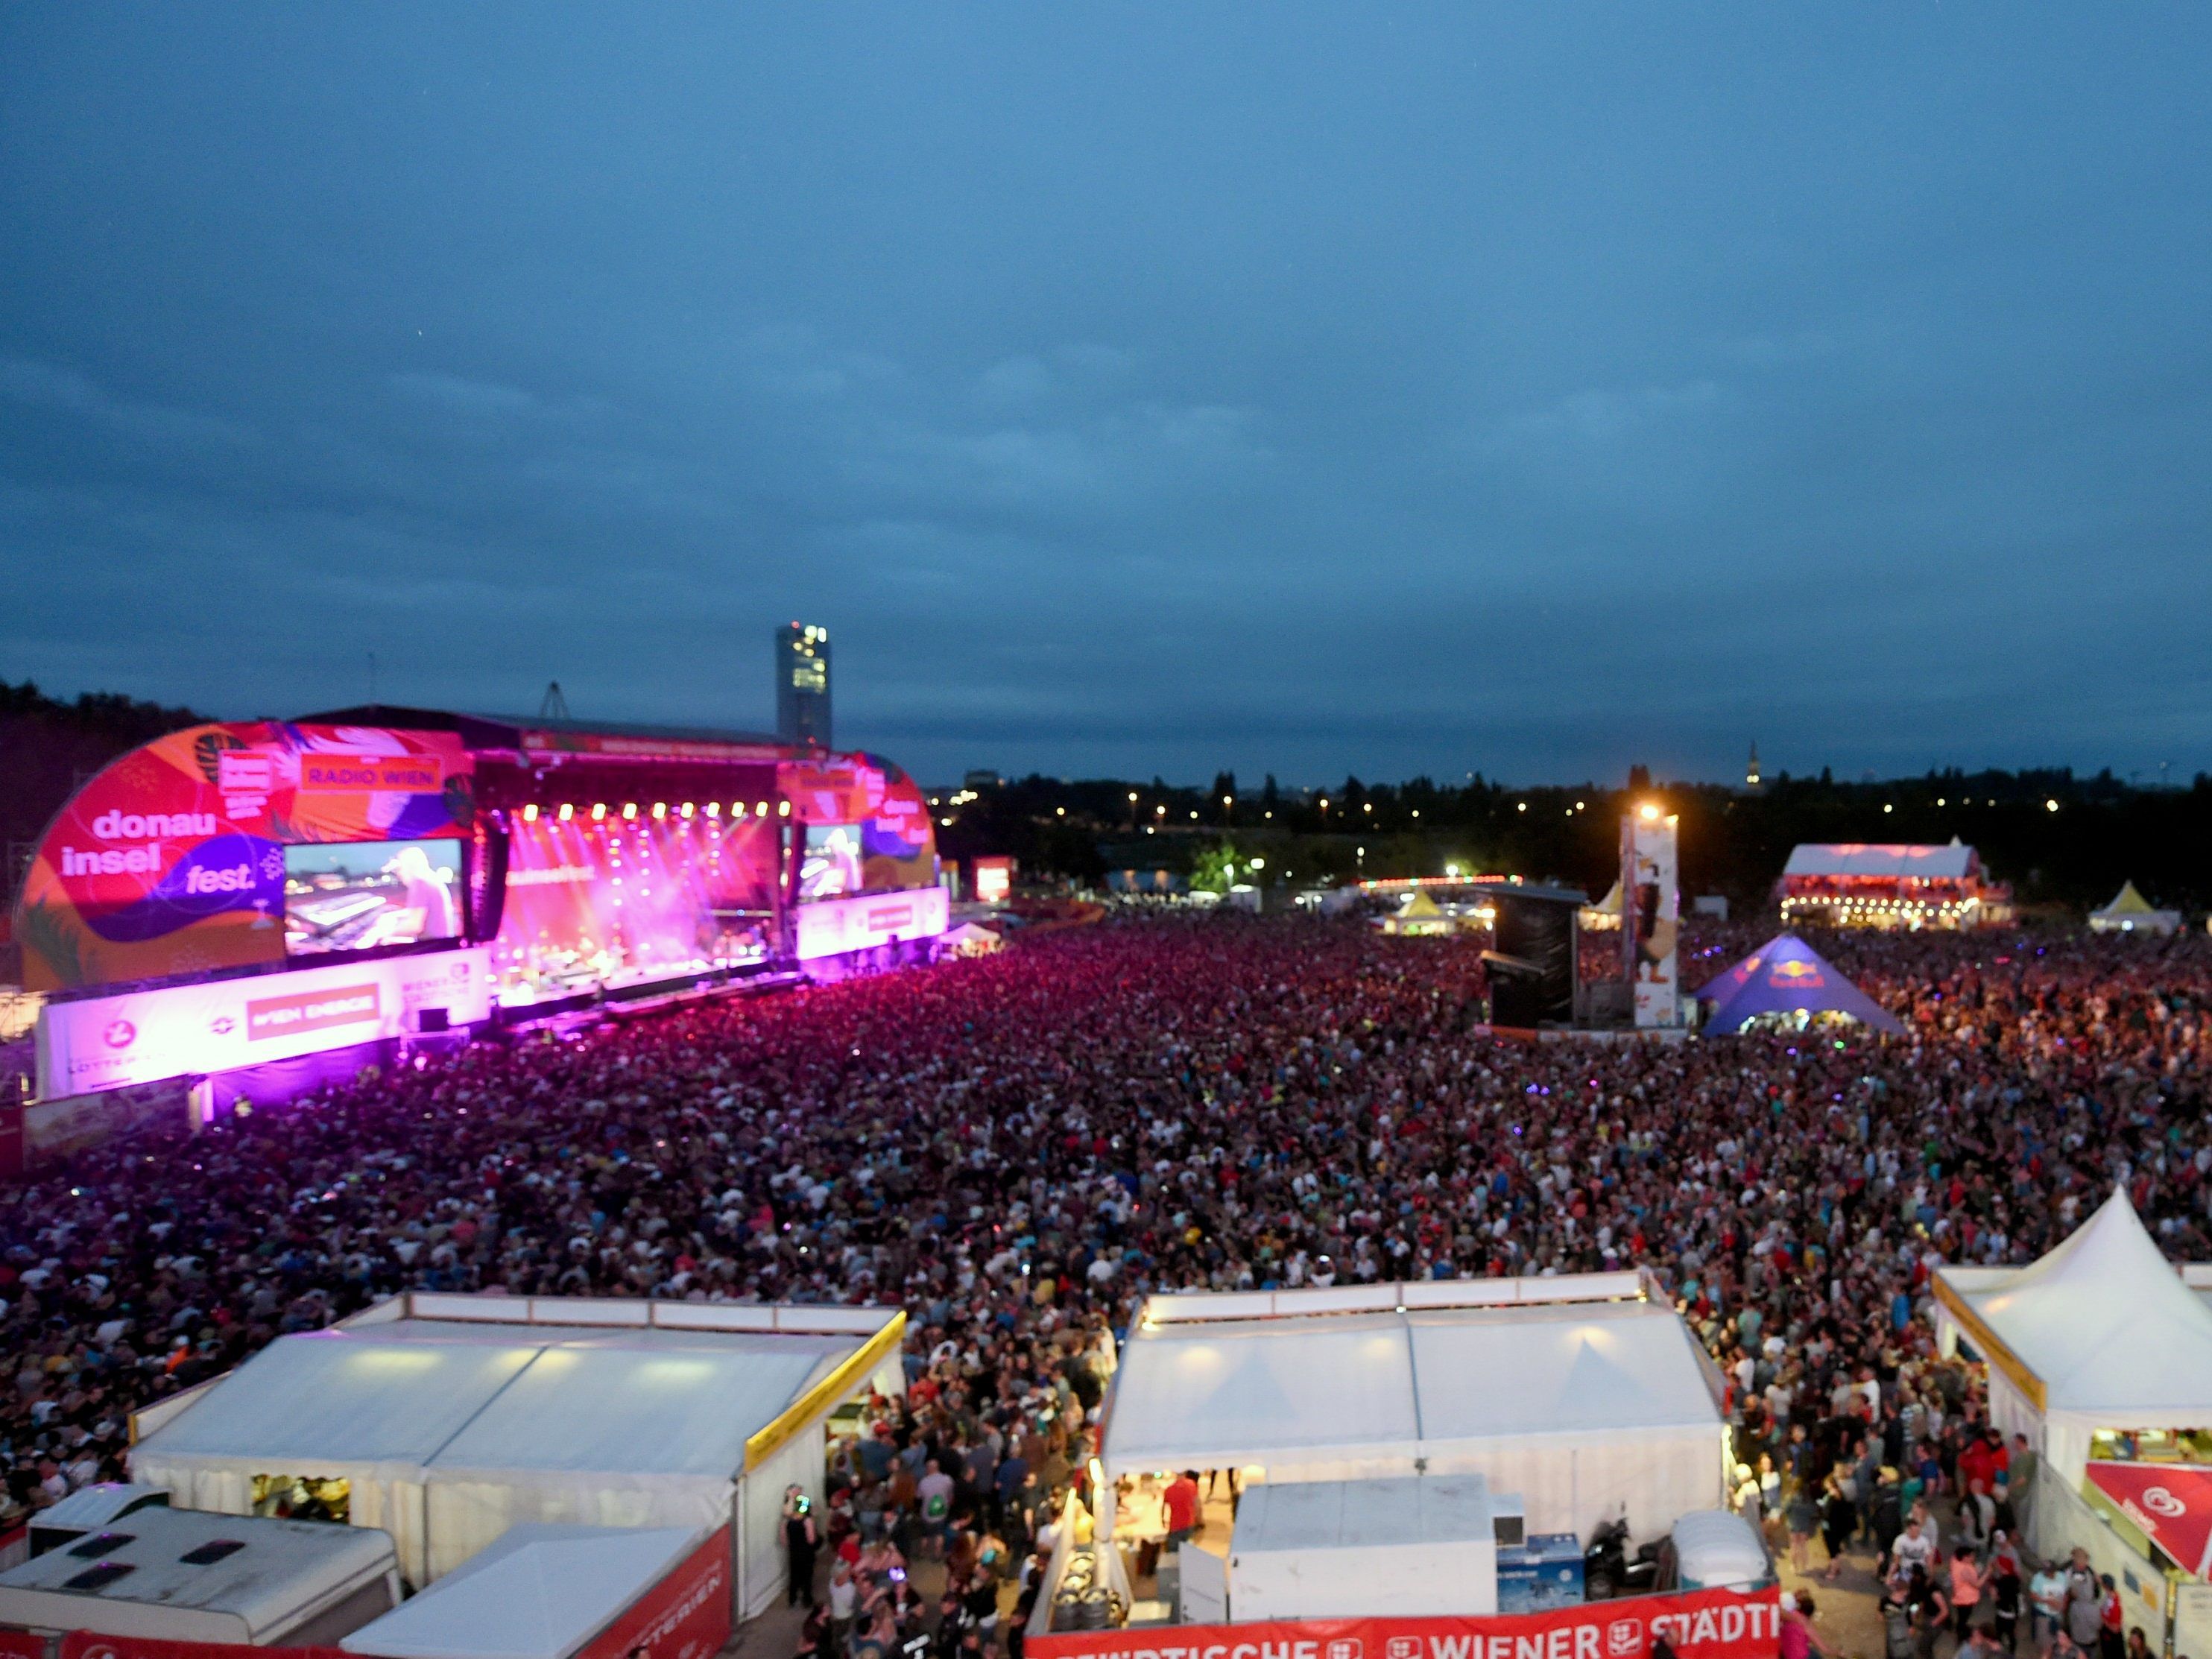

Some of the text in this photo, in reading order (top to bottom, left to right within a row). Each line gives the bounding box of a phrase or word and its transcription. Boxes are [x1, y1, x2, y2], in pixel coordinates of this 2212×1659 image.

[308, 767, 434, 786] RADIO WIEN
[92, 809, 217, 839] donau
[61, 842, 161, 876] insel
[186, 863, 256, 894] fest.
[1428, 1624, 1602, 1659] WIENER
